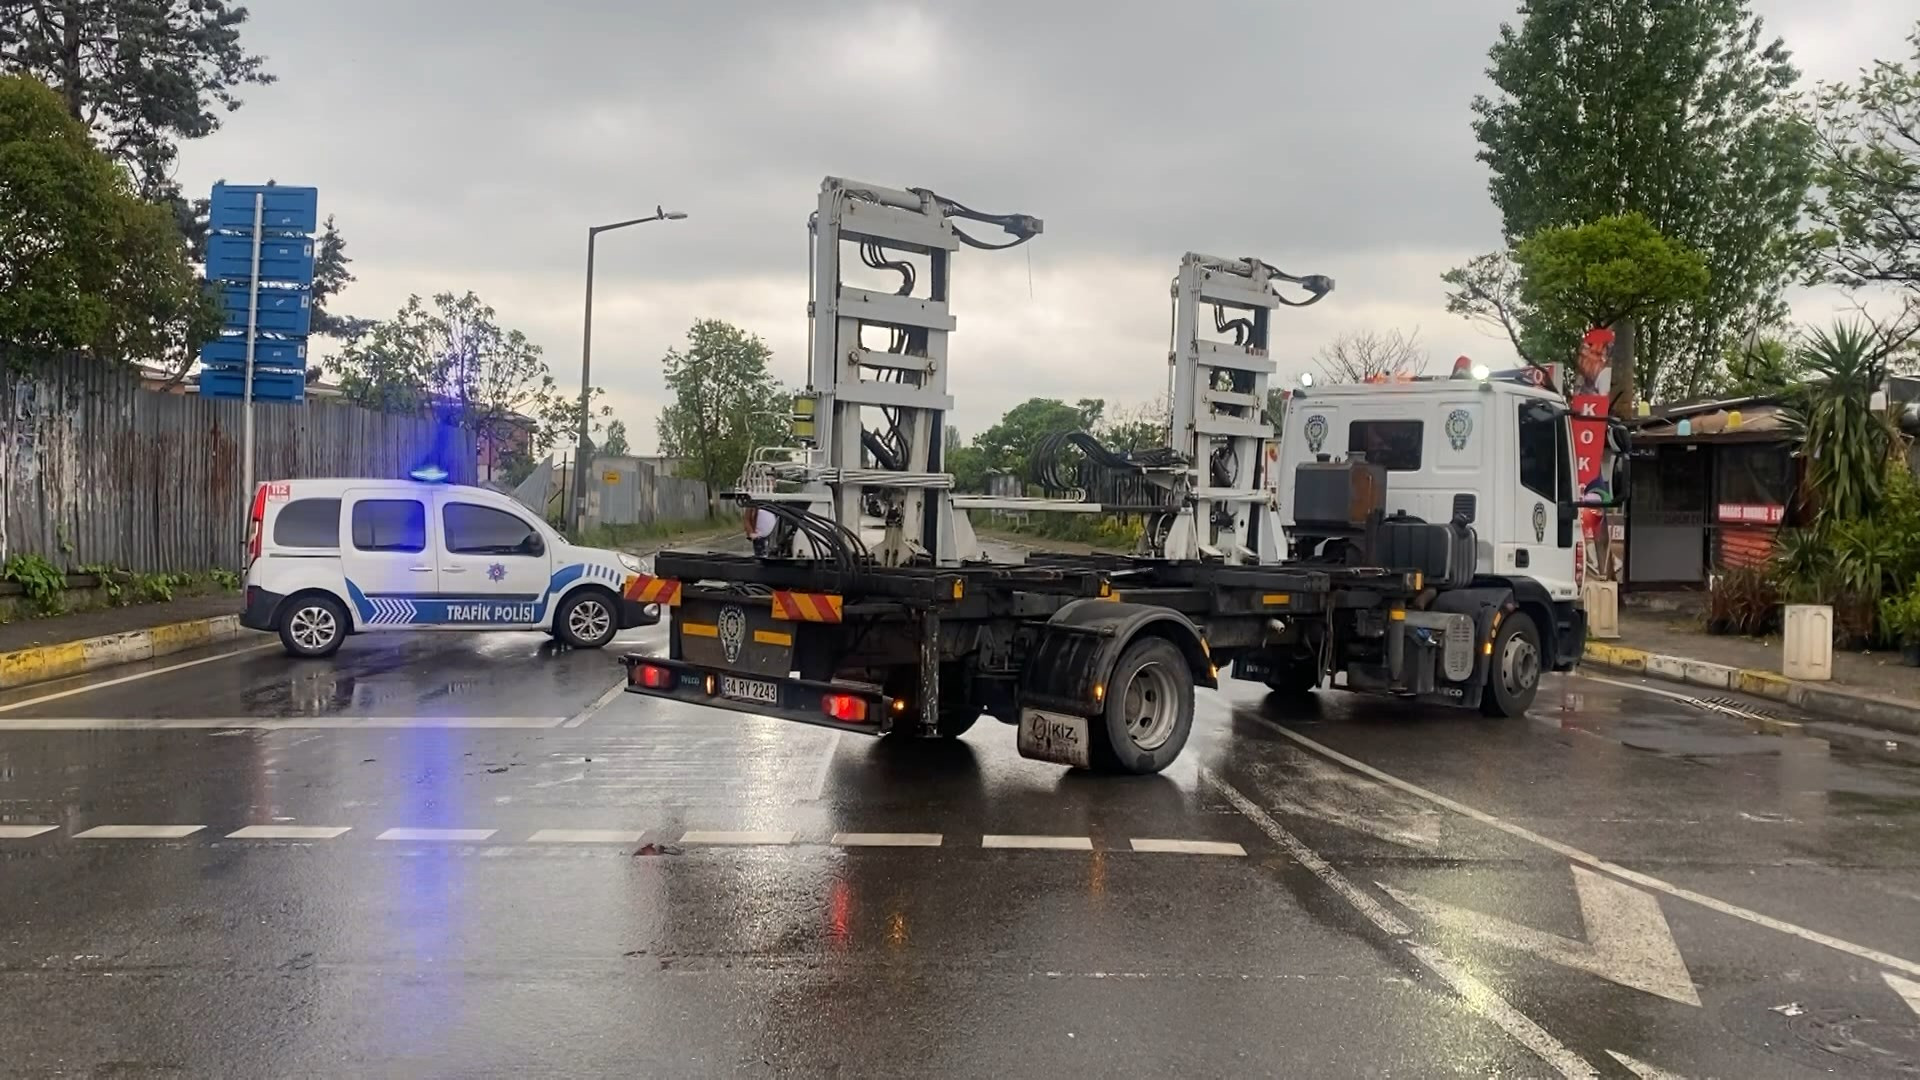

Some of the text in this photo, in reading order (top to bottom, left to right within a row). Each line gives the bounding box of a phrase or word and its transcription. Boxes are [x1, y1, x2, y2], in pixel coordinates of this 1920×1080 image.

[272, 484, 288, 495] 112
[447, 603, 535, 622] TRAFİK POLİSİ
[725, 679, 776, 700] 34 RY 2243
